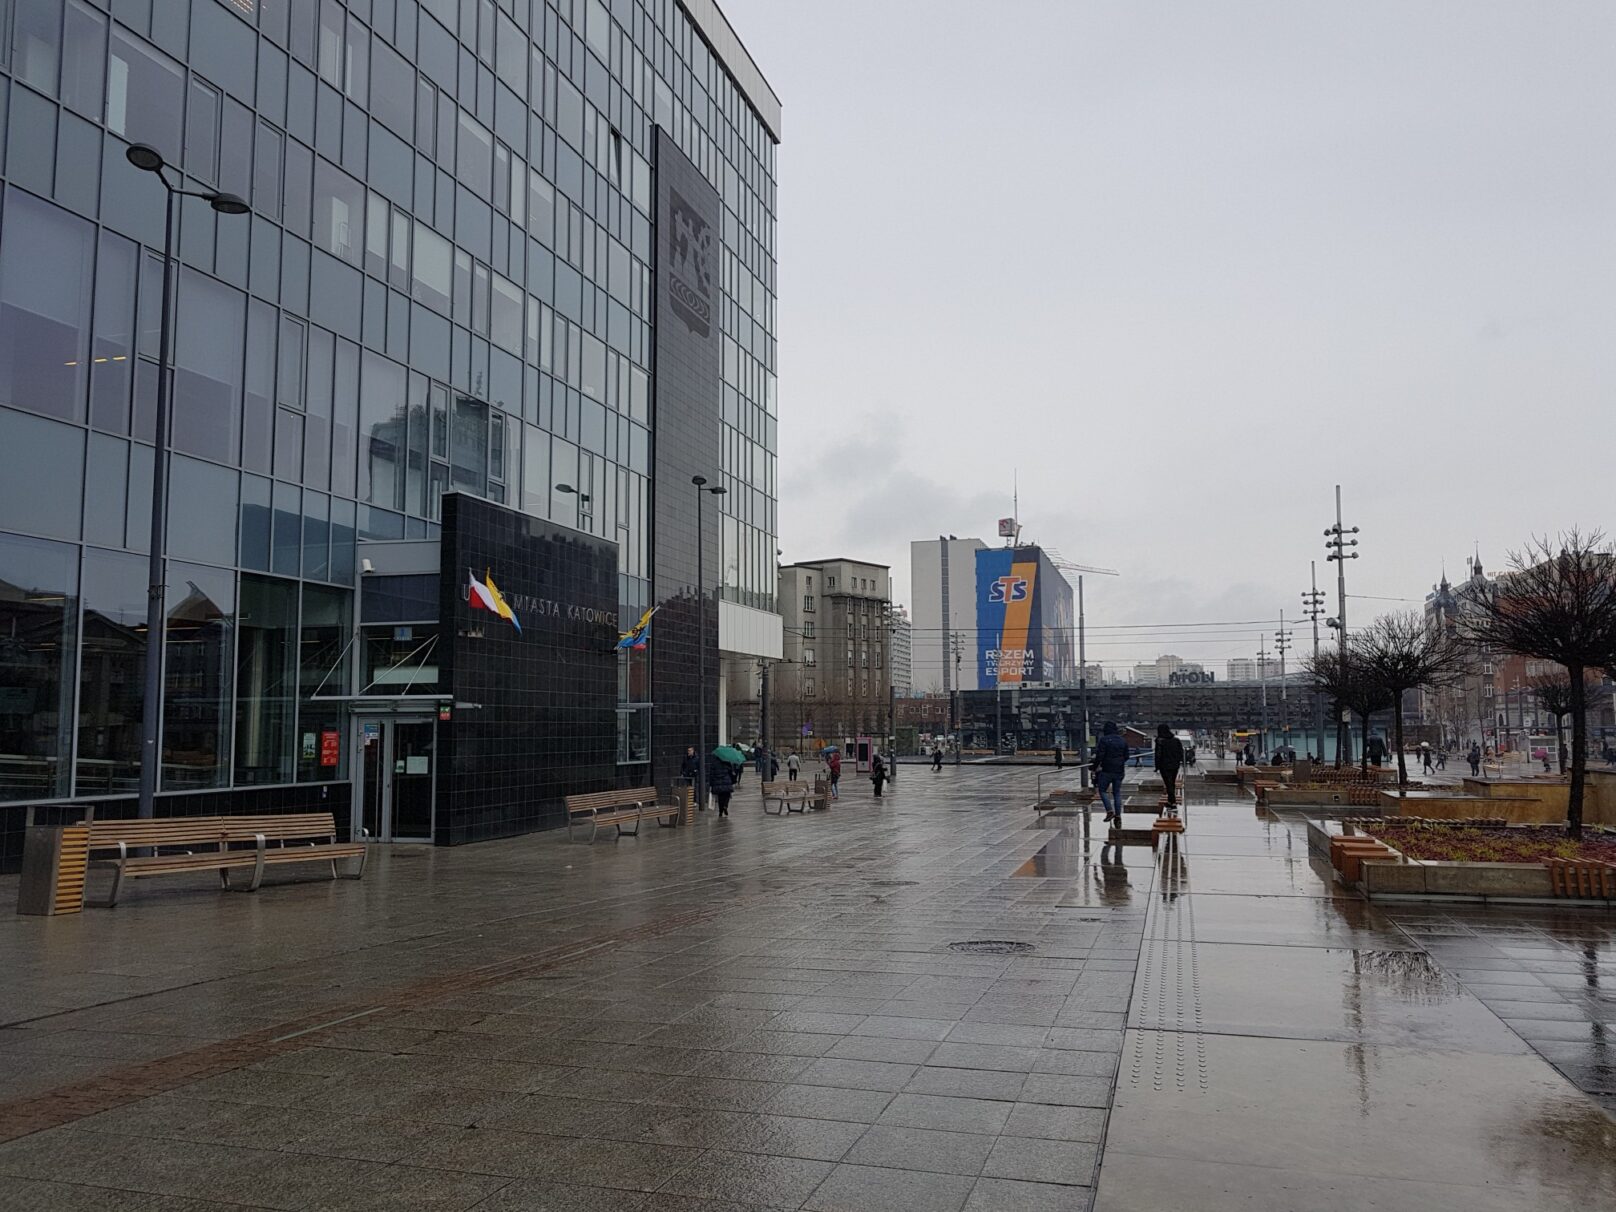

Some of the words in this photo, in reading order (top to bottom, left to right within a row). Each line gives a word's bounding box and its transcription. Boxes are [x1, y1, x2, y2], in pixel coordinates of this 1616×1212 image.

[989, 575, 1028, 604] STS
[513, 595, 560, 617] MIASTA
[567, 604, 618, 627] KATOWICE
[985, 667, 1034, 676] ESPORT
